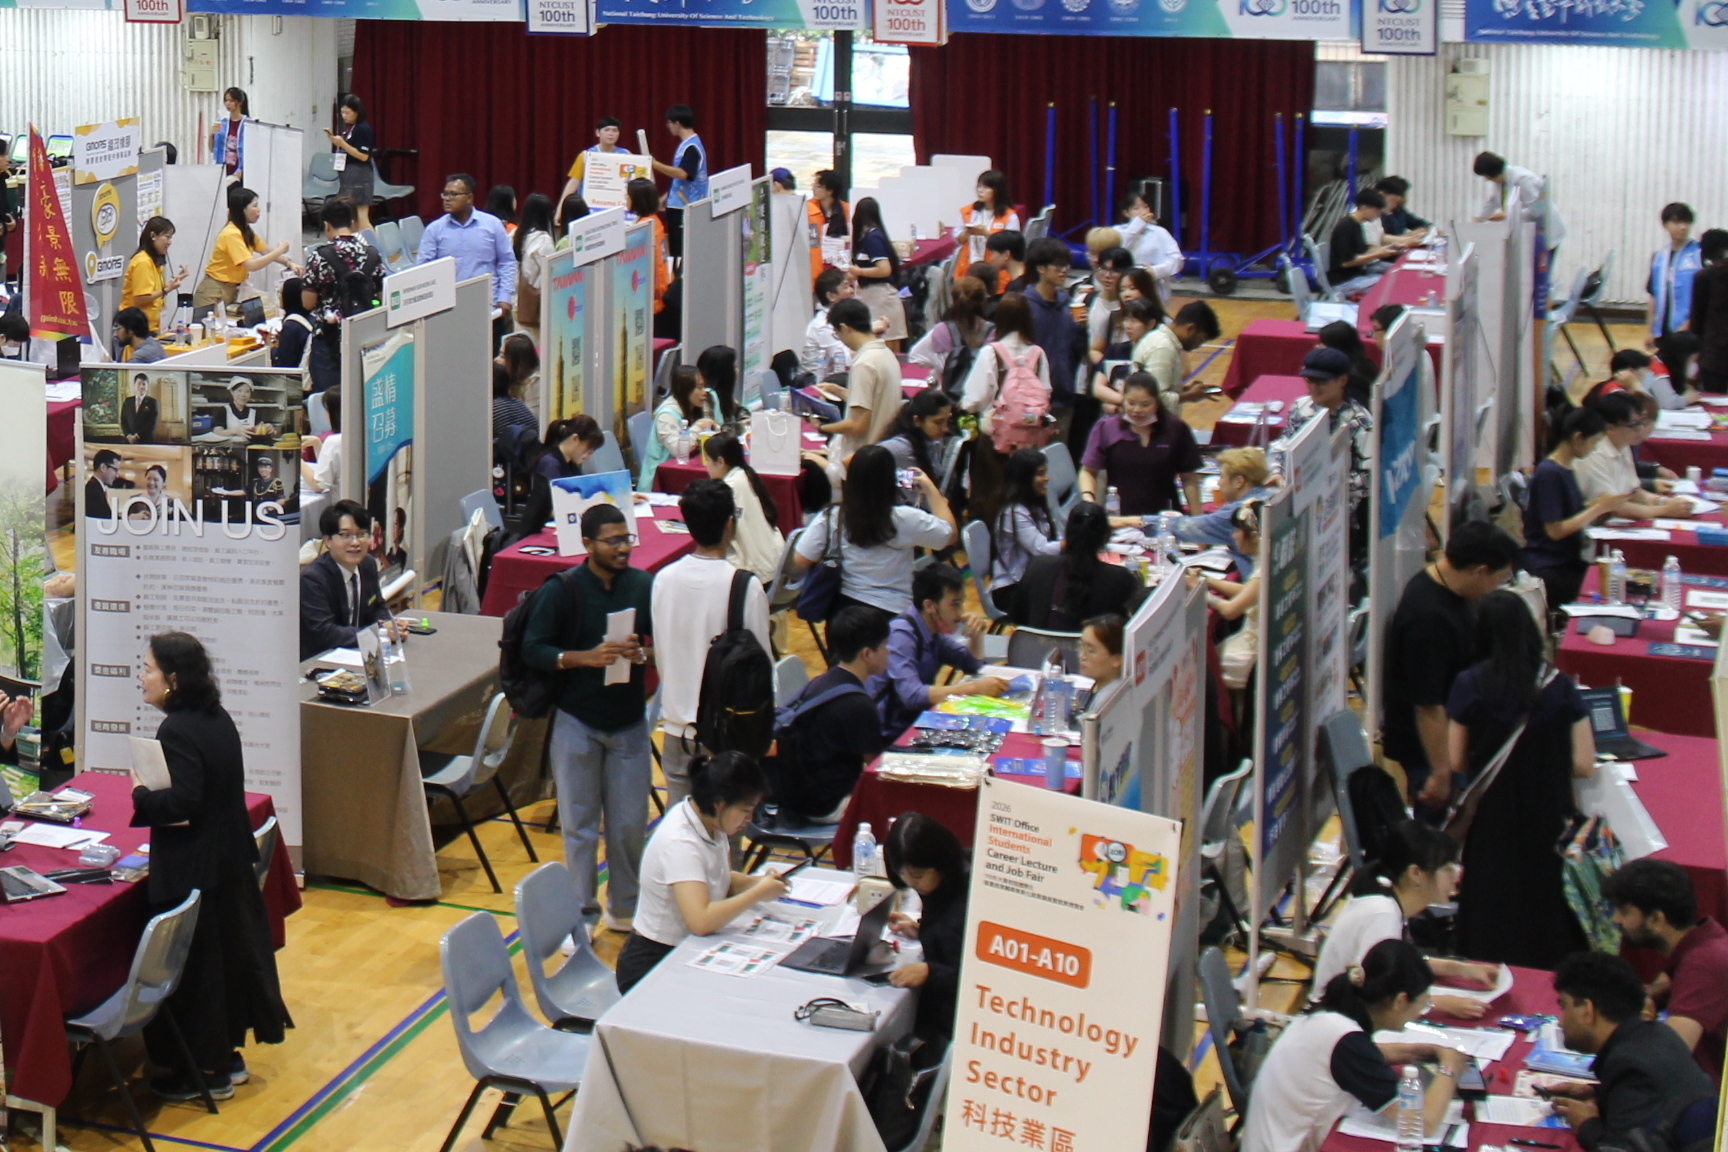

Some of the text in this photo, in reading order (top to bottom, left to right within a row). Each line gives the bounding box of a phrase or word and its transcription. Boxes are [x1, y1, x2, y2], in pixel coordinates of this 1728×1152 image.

[136, 0, 169, 11] 100th
[539, 2, 575, 10] NTCUST
[813, 5, 856, 21] 100th
[887, 9, 925, 17] NTCUST
[1291, 0, 1341, 15] 100th
[539, 10, 575, 23] 100th
[887, 18, 925, 31] 100th
[1378, 18, 1420, 26] NTCUST
[1377, 28, 1420, 41] 100th
[96, 497, 287, 541] JOIN US
[991, 800, 1012, 813] 2026
[990, 813, 1040, 833] SWIT Office
[989, 824, 1052, 847] International
[988, 836, 1031, 854] Students
[987, 848, 1059, 874] Career Lecture
[986, 862, 1045, 883] and Job Fair
[989, 934, 1080, 978] A01-A10
[976, 984, 1139, 1059] Technology
[971, 1021, 1092, 1083] Industry
[967, 1060, 1057, 1107] Sector
[962, 1098, 1077, 1152] 科技業區
